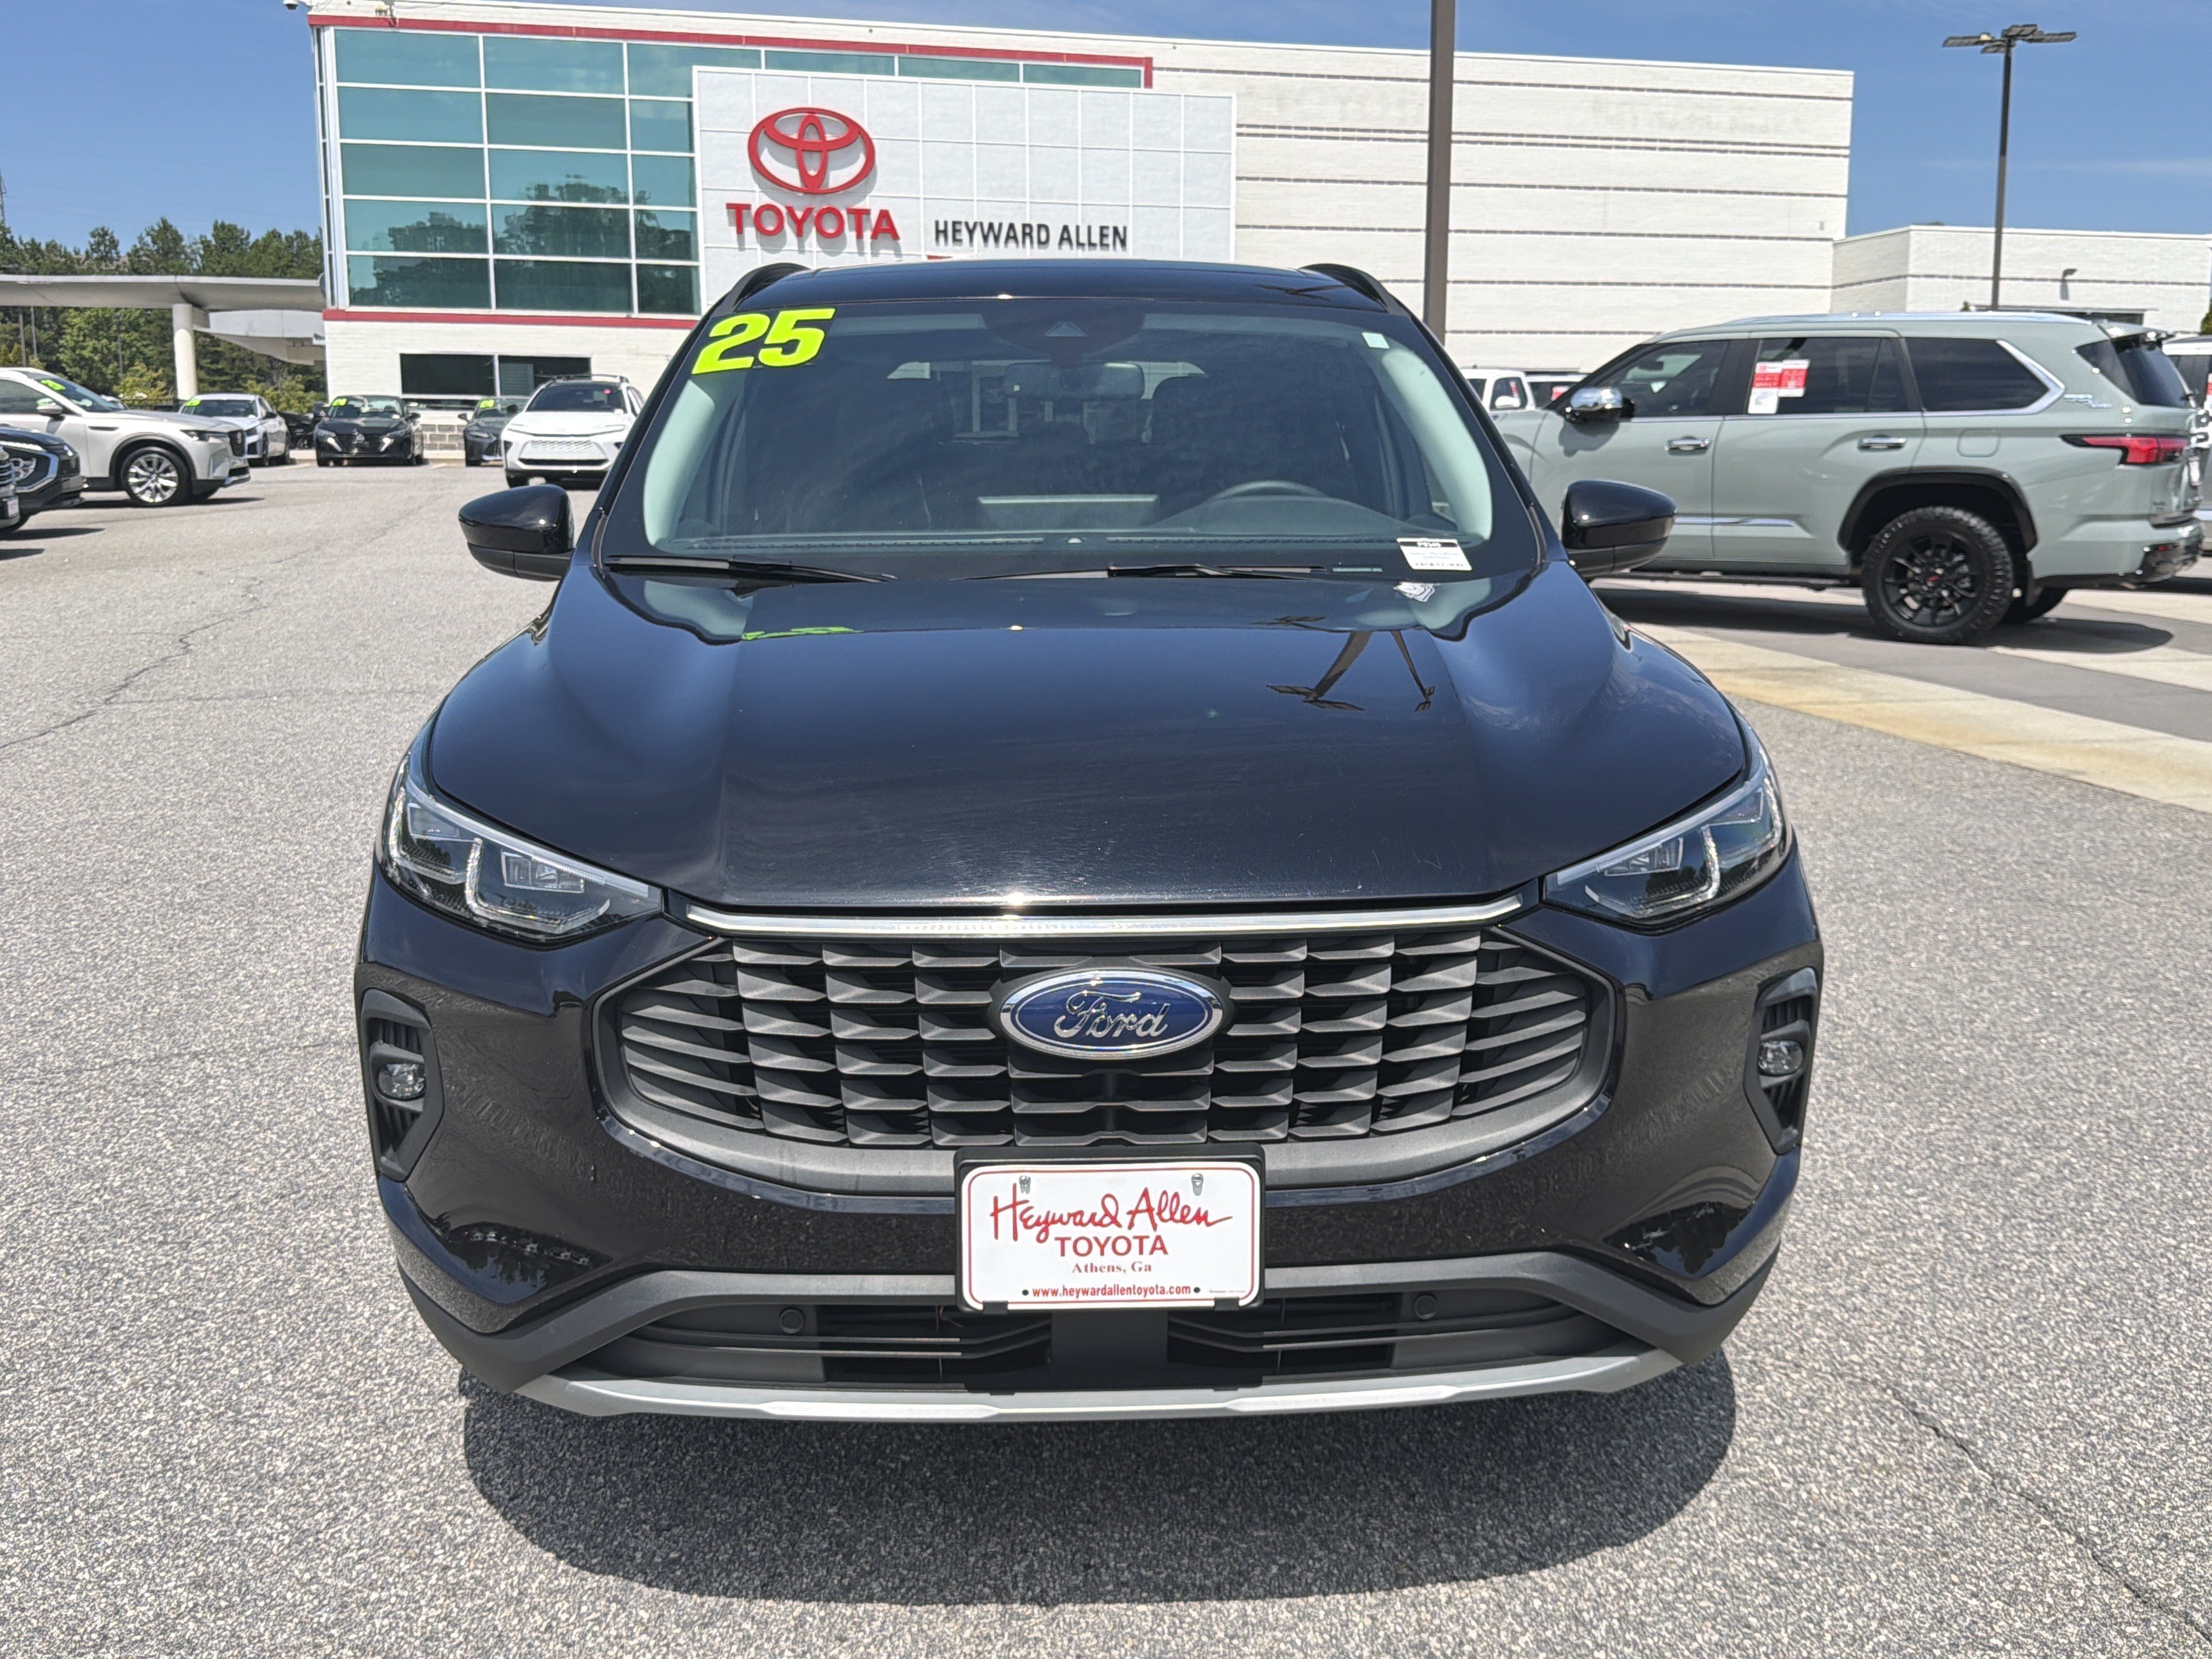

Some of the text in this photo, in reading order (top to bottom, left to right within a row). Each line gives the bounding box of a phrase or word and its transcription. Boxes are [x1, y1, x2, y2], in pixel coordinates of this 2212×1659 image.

[726, 203, 900, 241] TOYOTA
[934, 220, 1127, 250] HEYWARD ALLEN
[691, 308, 837, 375] 25
[1053, 990, 1171, 1038] Ford
[989, 1182, 1233, 1244] Heyward Allen
[1054, 1234, 1169, 1257] TOYOTA
[1071, 1261, 1152, 1274] Athens, Ga
[1032, 1284, 1191, 1299] www.heywardallentoyota.com
